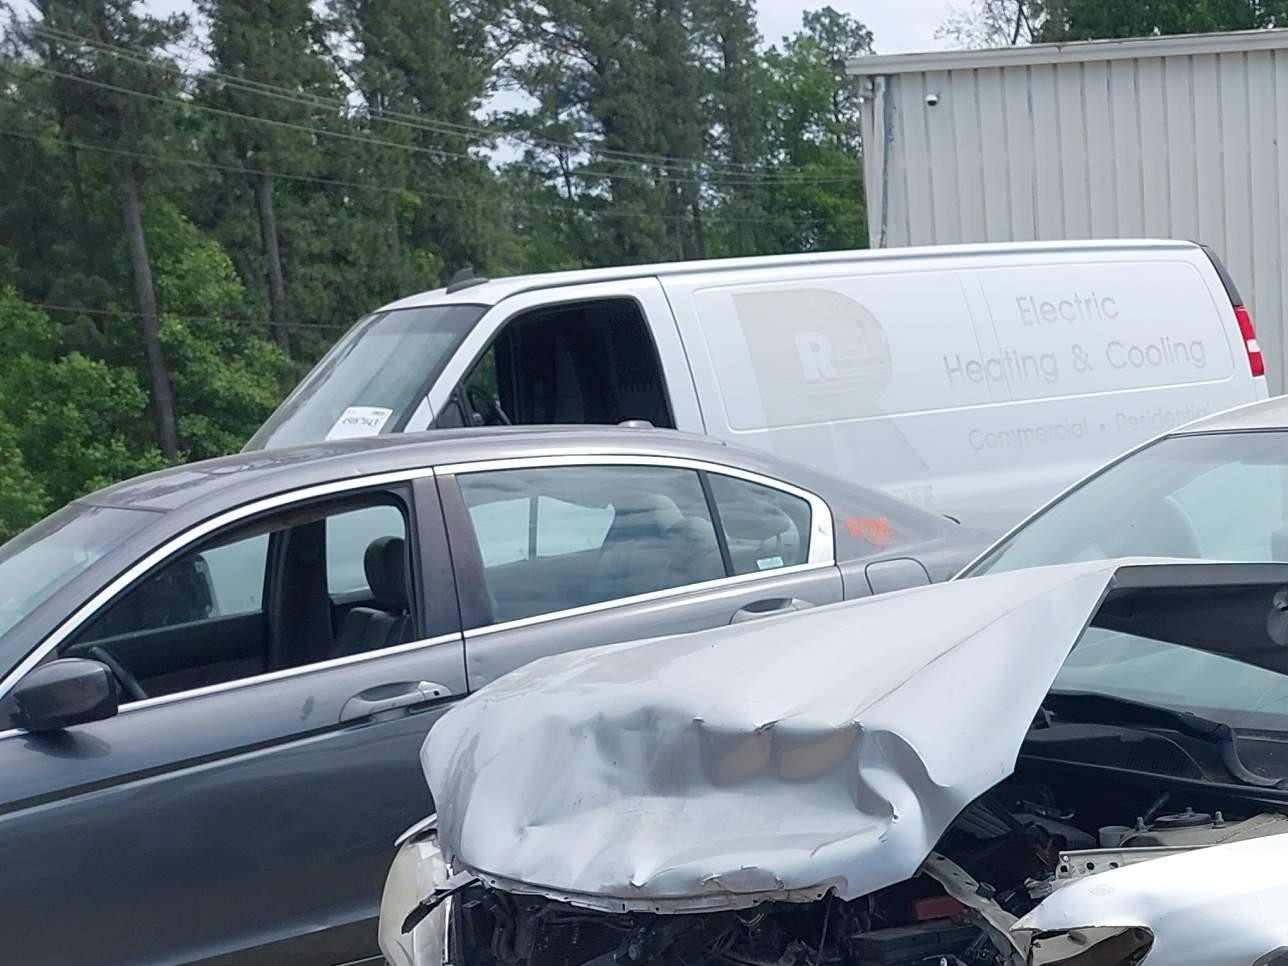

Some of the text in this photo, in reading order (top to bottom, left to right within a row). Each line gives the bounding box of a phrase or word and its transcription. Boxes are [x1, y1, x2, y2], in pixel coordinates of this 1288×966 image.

[1015, 292, 1119, 325] Electric
[943, 336, 1206, 384] Heating & Cooling
[968, 417, 1088, 451] Commercial
